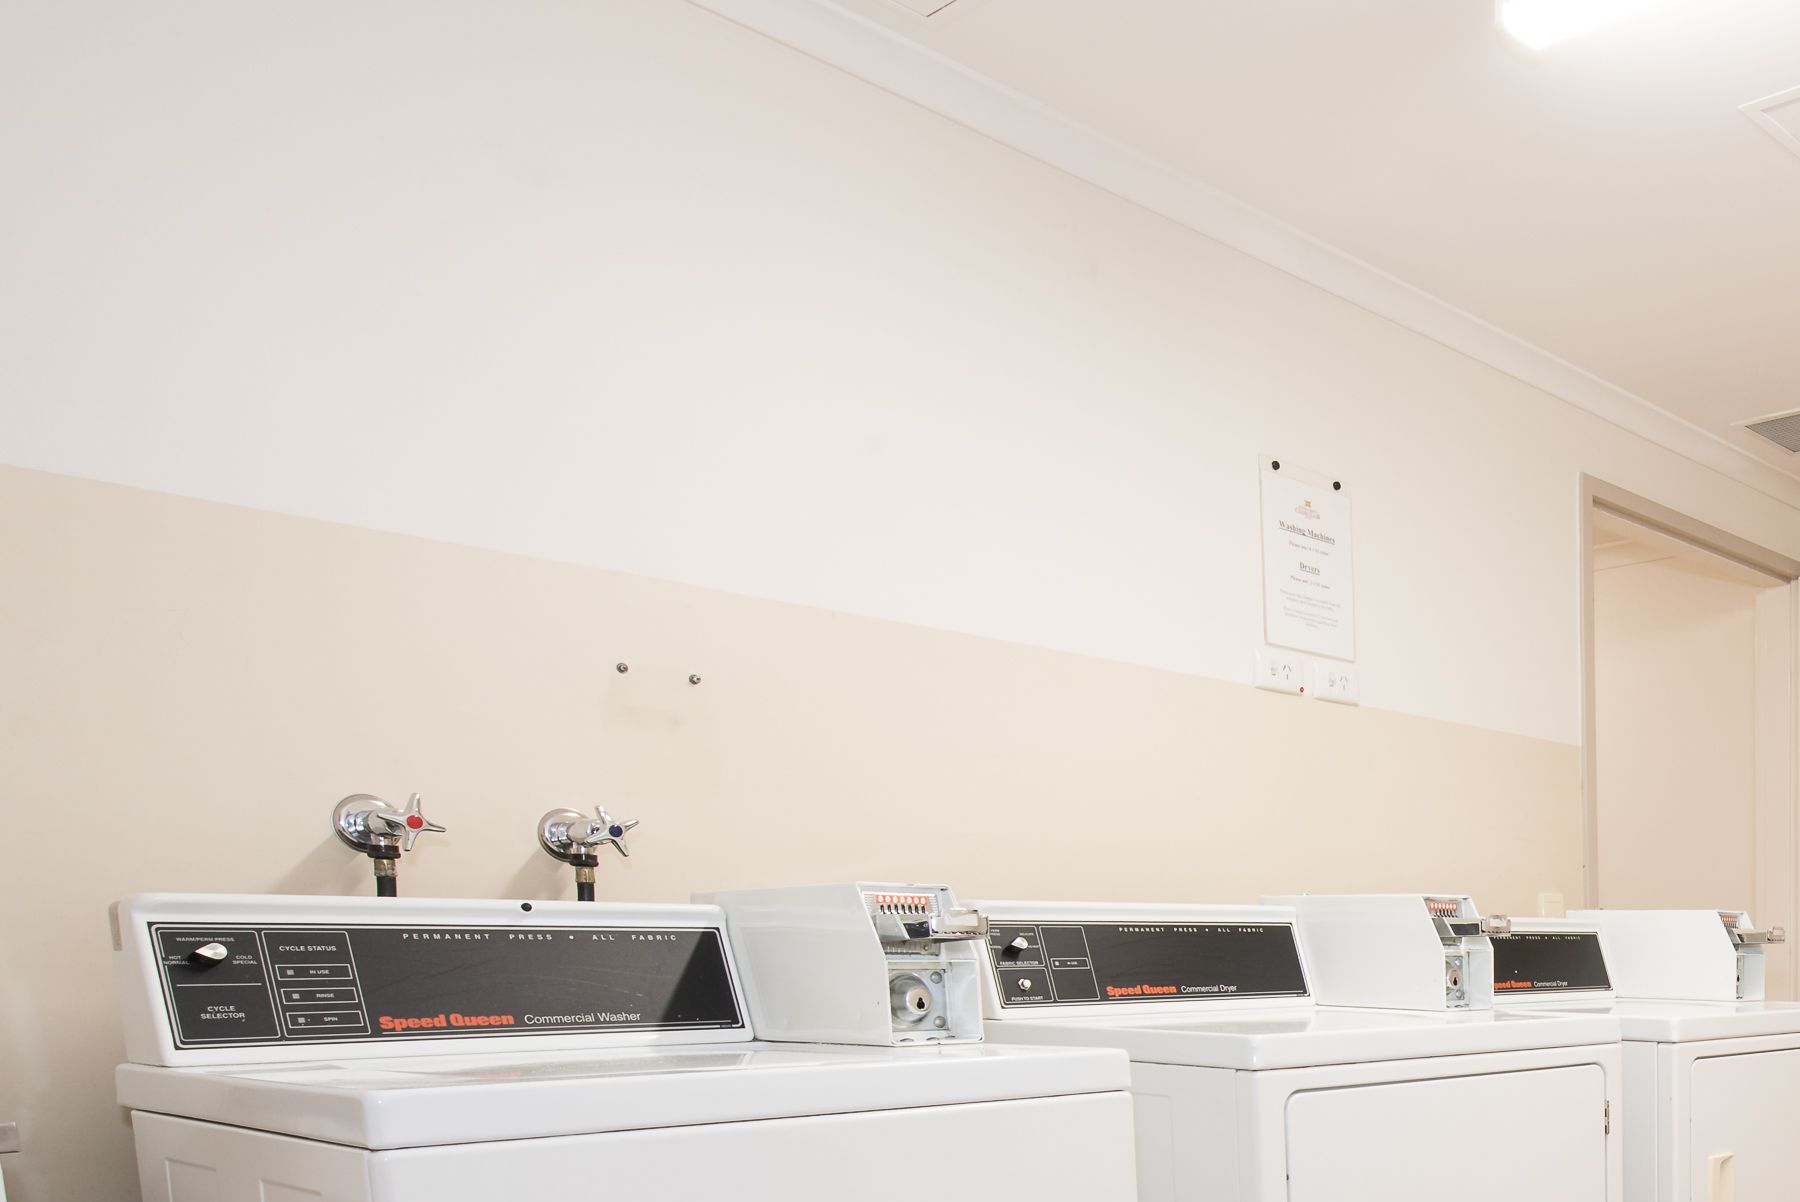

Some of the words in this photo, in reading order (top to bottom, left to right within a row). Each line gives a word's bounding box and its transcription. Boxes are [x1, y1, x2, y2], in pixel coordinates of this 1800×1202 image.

[1307, 528, 1336, 543] Machines
[1106, 985, 1142, 998] Speed
[1142, 984, 1177, 995] Queen
[1181, 985, 1220, 994] Commercial
[1220, 984, 1238, 994] Dryer
[1494, 981, 1511, 990] peed
[200, 1012, 246, 1020] SELECTOR
[379, 1013, 448, 1032] Speed
[450, 1013, 515, 1027] Queen
[524, 1012, 595, 1024] Commercial
[597, 1011, 641, 1022] Washer
